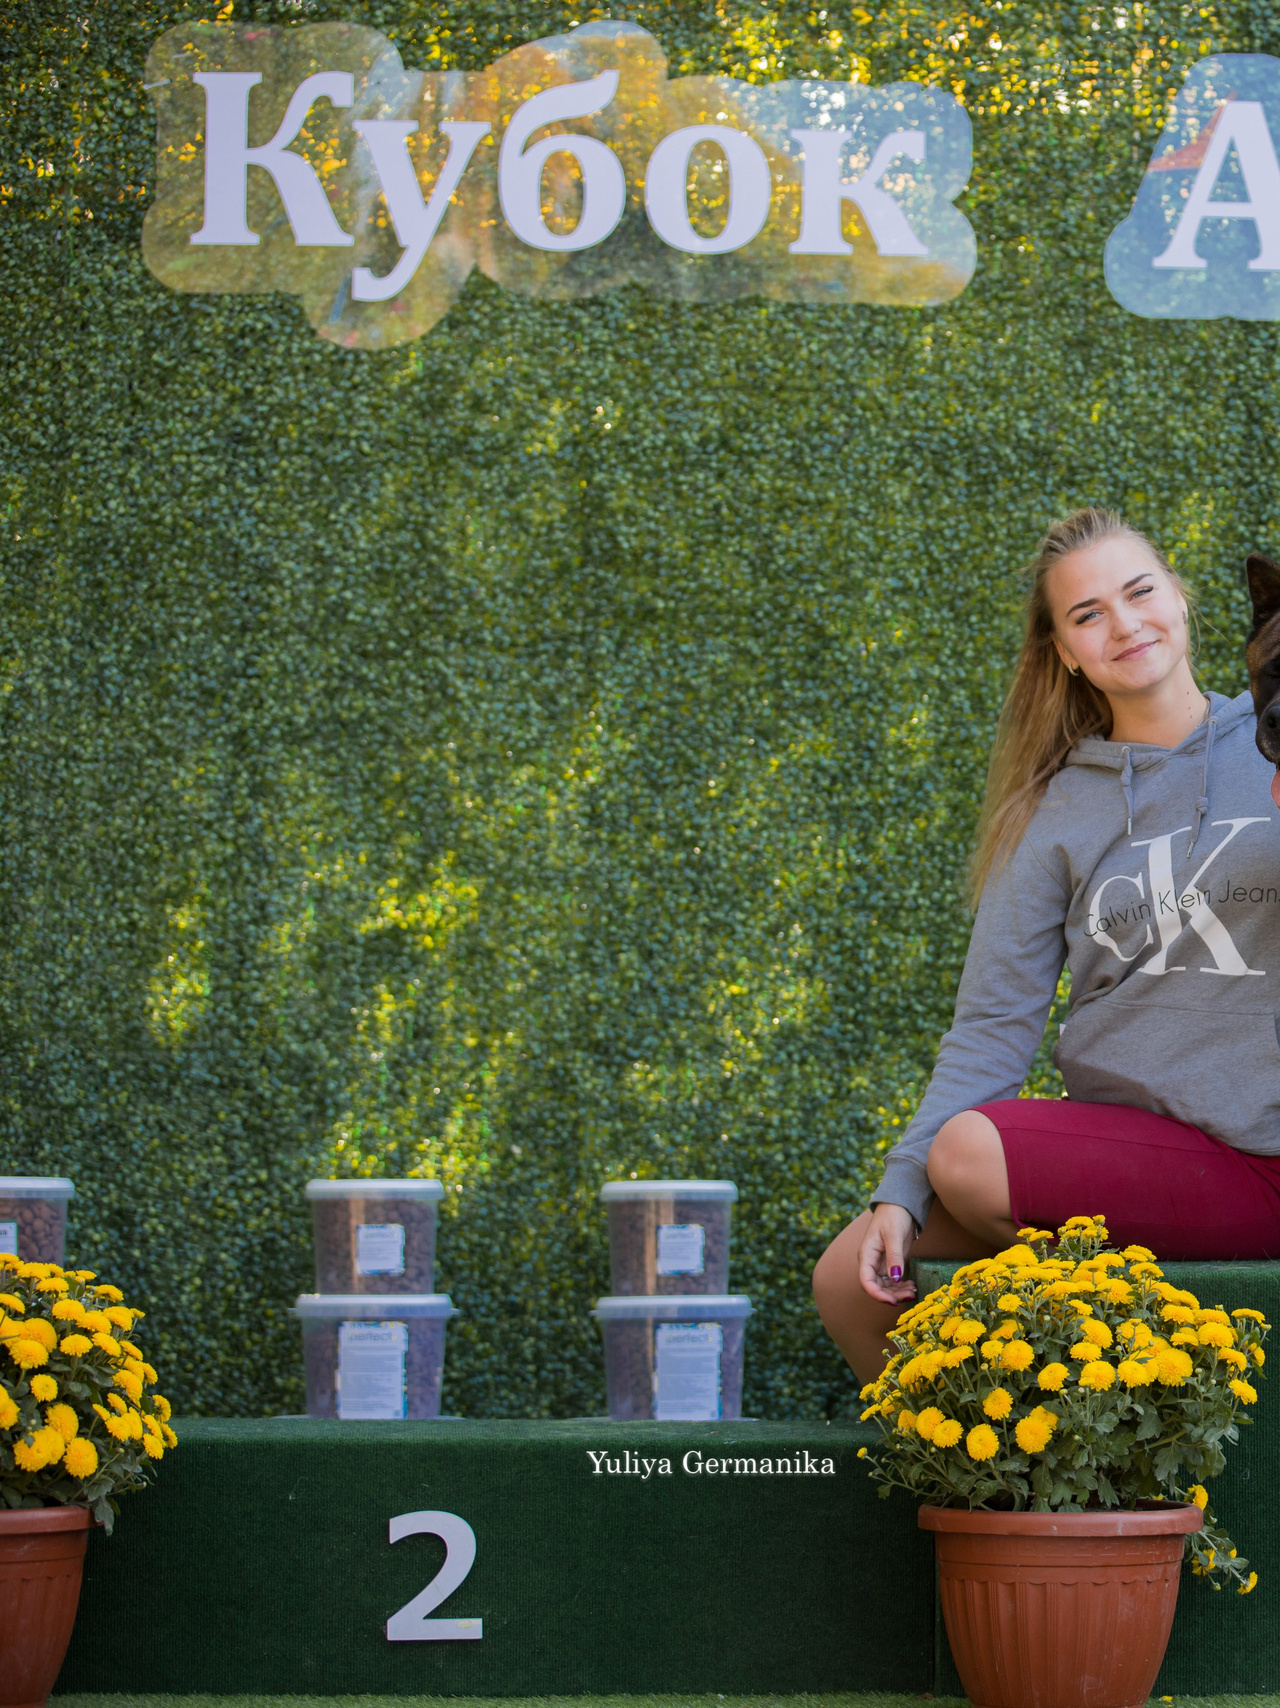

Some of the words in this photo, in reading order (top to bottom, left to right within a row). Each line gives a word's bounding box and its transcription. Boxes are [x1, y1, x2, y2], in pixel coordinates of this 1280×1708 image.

[190, 69, 930, 301] Кубок
[1084, 902, 1151, 937] Calvin
[1158, 888, 1211, 916] Klein
[1088, 817, 1271, 975] CK
[386, 1510, 483, 1642] 2
